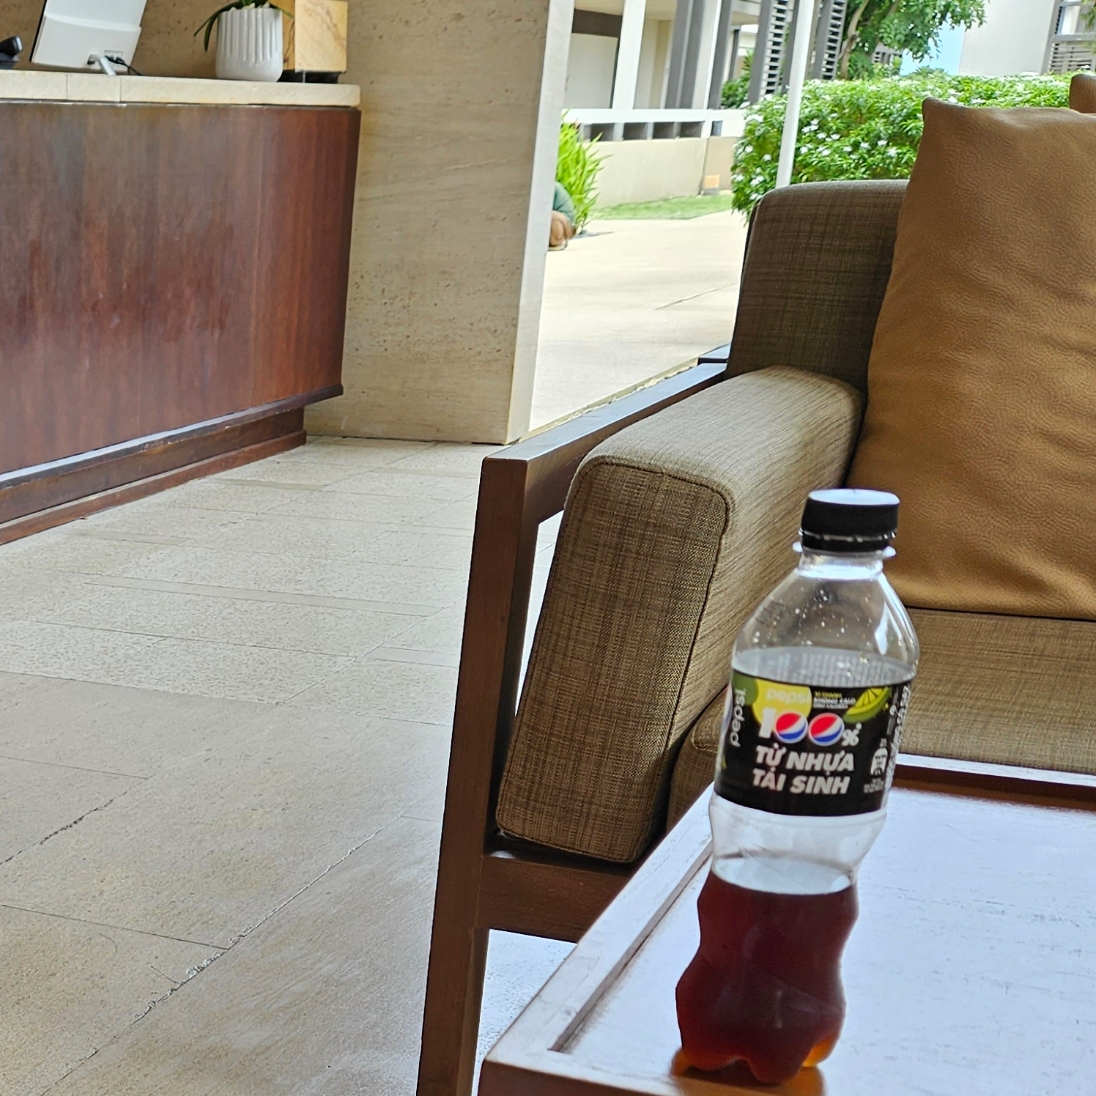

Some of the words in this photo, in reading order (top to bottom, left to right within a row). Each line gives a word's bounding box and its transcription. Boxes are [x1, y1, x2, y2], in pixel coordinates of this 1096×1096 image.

[766, 688, 811, 705] pepsi
[730, 689, 746, 747] pepsi
[790, 775, 850, 795] SINH
